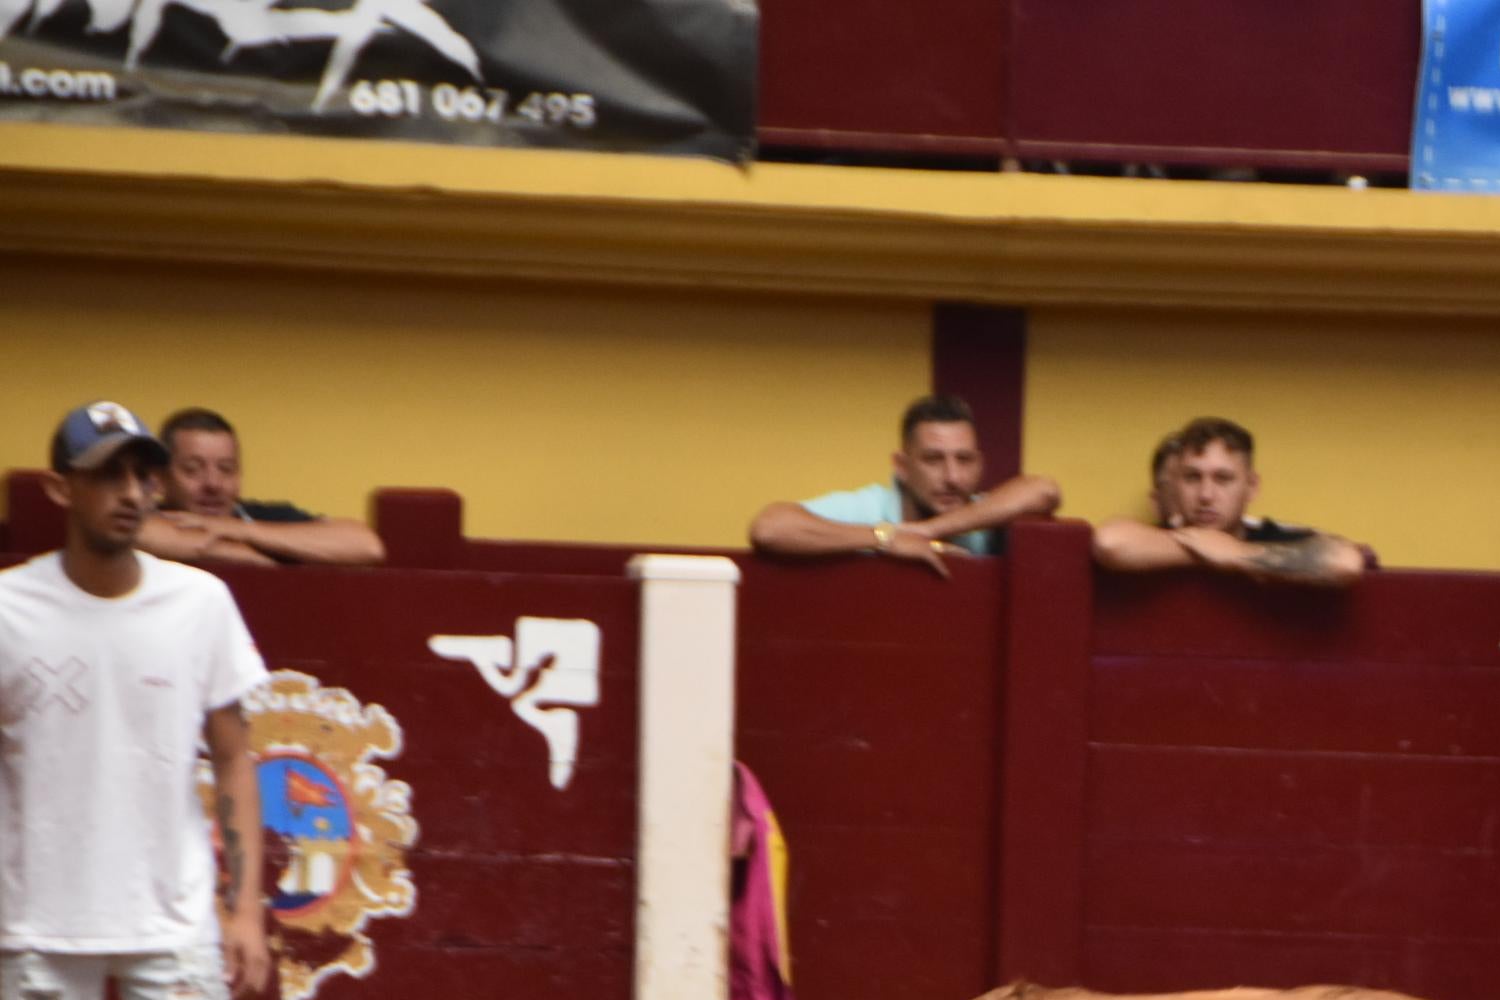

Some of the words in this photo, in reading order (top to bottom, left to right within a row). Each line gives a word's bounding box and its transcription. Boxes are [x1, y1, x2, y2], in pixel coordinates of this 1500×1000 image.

[350, 79, 422, 117] 681
[431, 82, 509, 124] 067
[516, 91, 597, 128] 495
